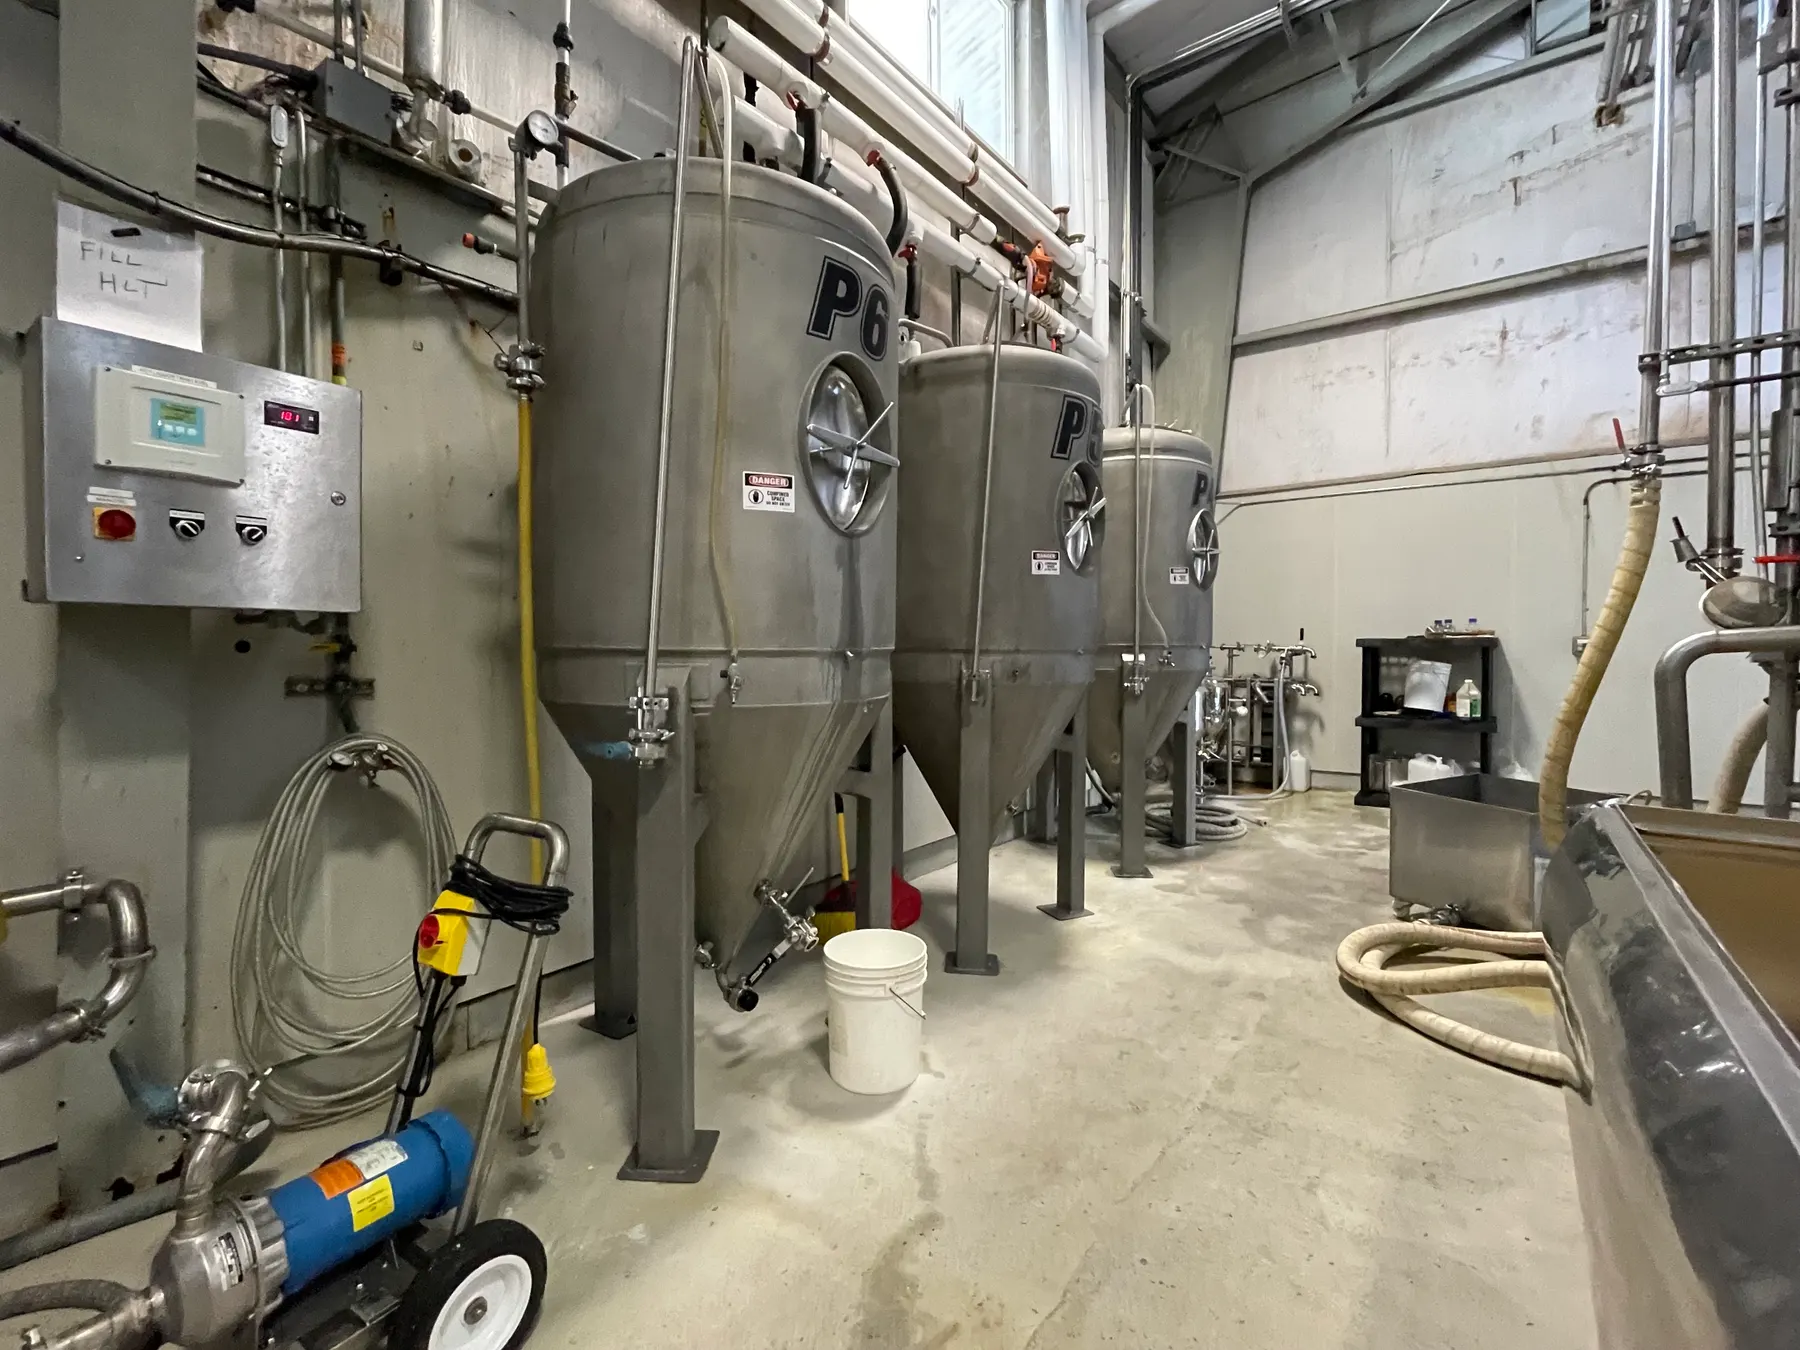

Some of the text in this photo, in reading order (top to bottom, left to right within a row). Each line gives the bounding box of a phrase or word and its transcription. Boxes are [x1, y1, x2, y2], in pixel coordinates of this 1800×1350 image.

[80, 241, 143, 266] FILL
[100, 271, 168, 299] HLT
[806, 255, 889, 361] P6
[752, 475, 787, 487] DANGER
[767, 490, 789, 498] CONFINED
